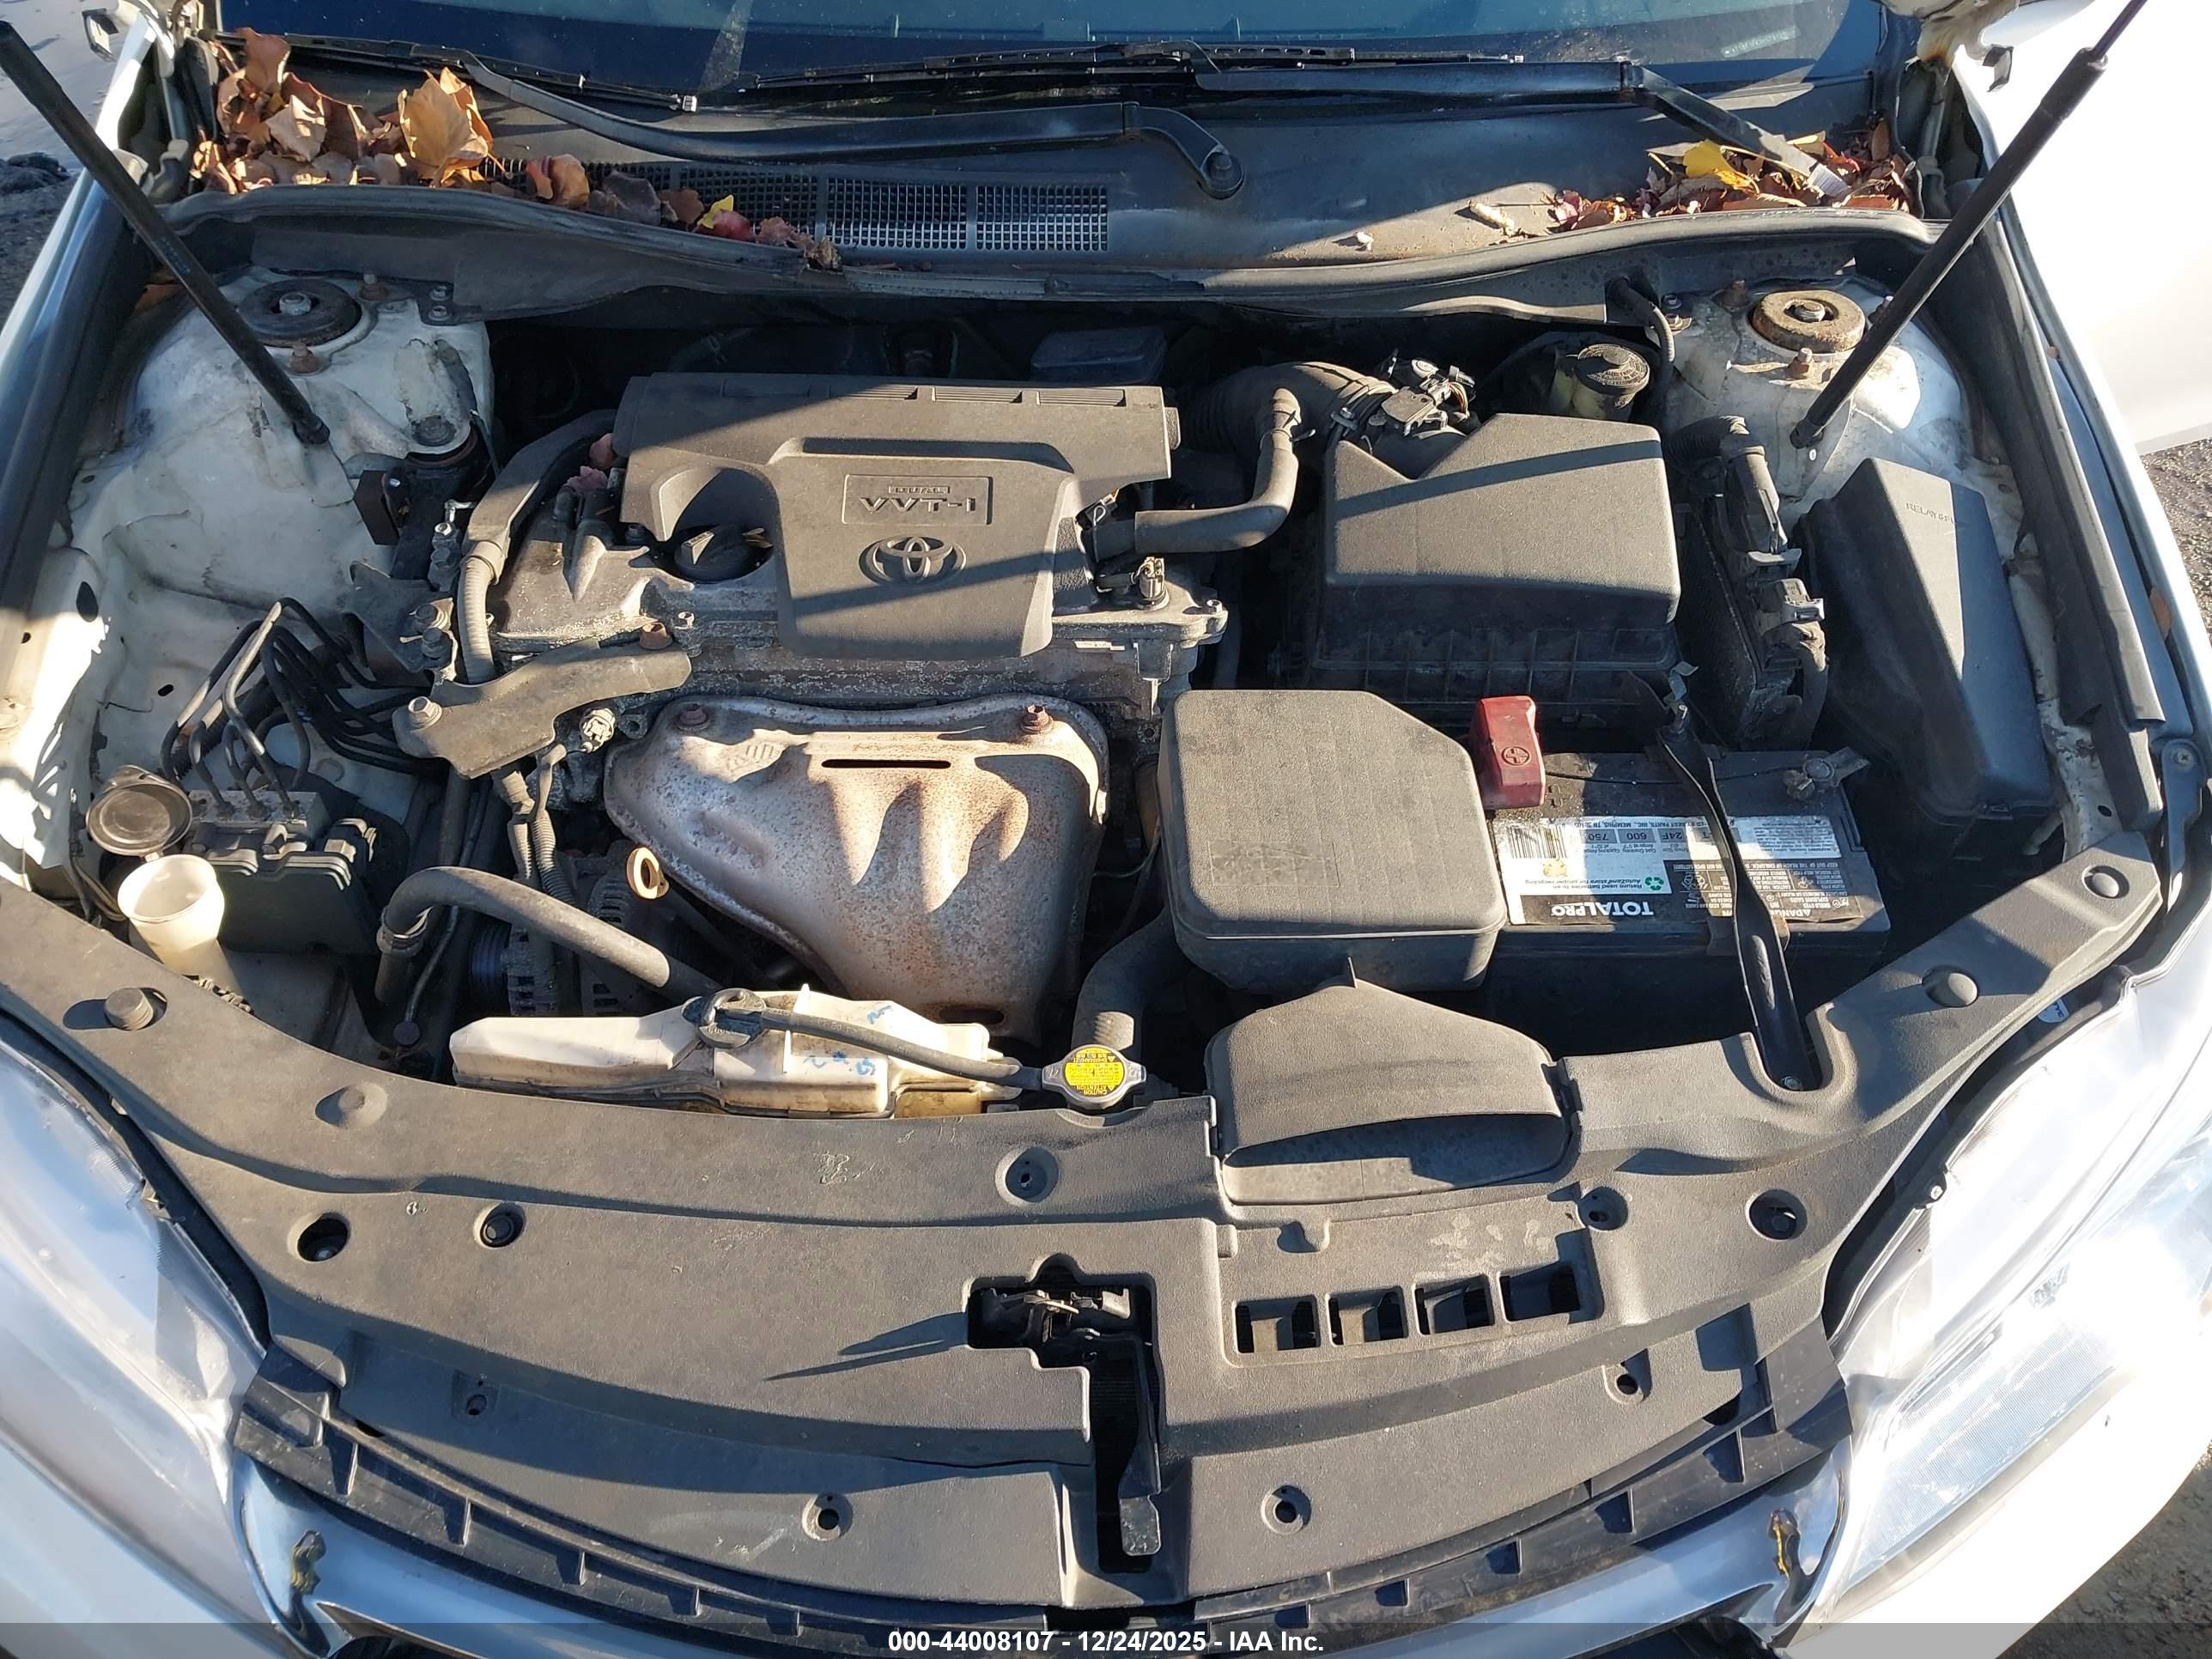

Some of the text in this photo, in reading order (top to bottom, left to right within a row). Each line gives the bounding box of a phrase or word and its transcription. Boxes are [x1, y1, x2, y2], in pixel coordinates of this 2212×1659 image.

[1905, 502, 1938, 520] RELAY
[1626, 832, 1647, 841] 600
[1551, 901, 1654, 917] TOTALPRO
